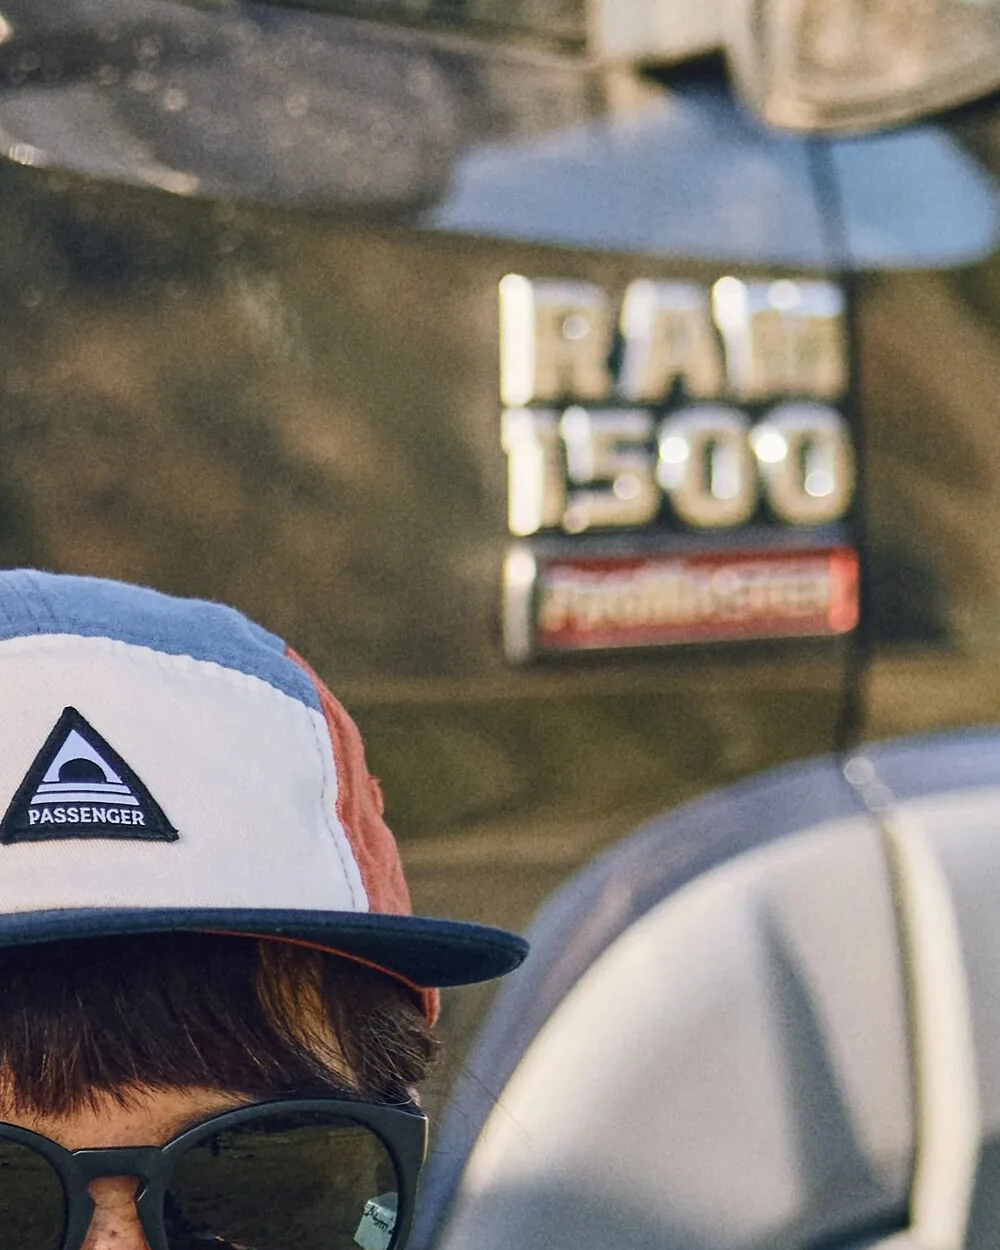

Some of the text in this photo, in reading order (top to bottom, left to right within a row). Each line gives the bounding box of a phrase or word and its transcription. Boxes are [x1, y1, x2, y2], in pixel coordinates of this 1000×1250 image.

[499, 273, 848, 404] RAM
[501, 404, 854, 536] 1500
[28, 807, 146, 826] PASSENGER
